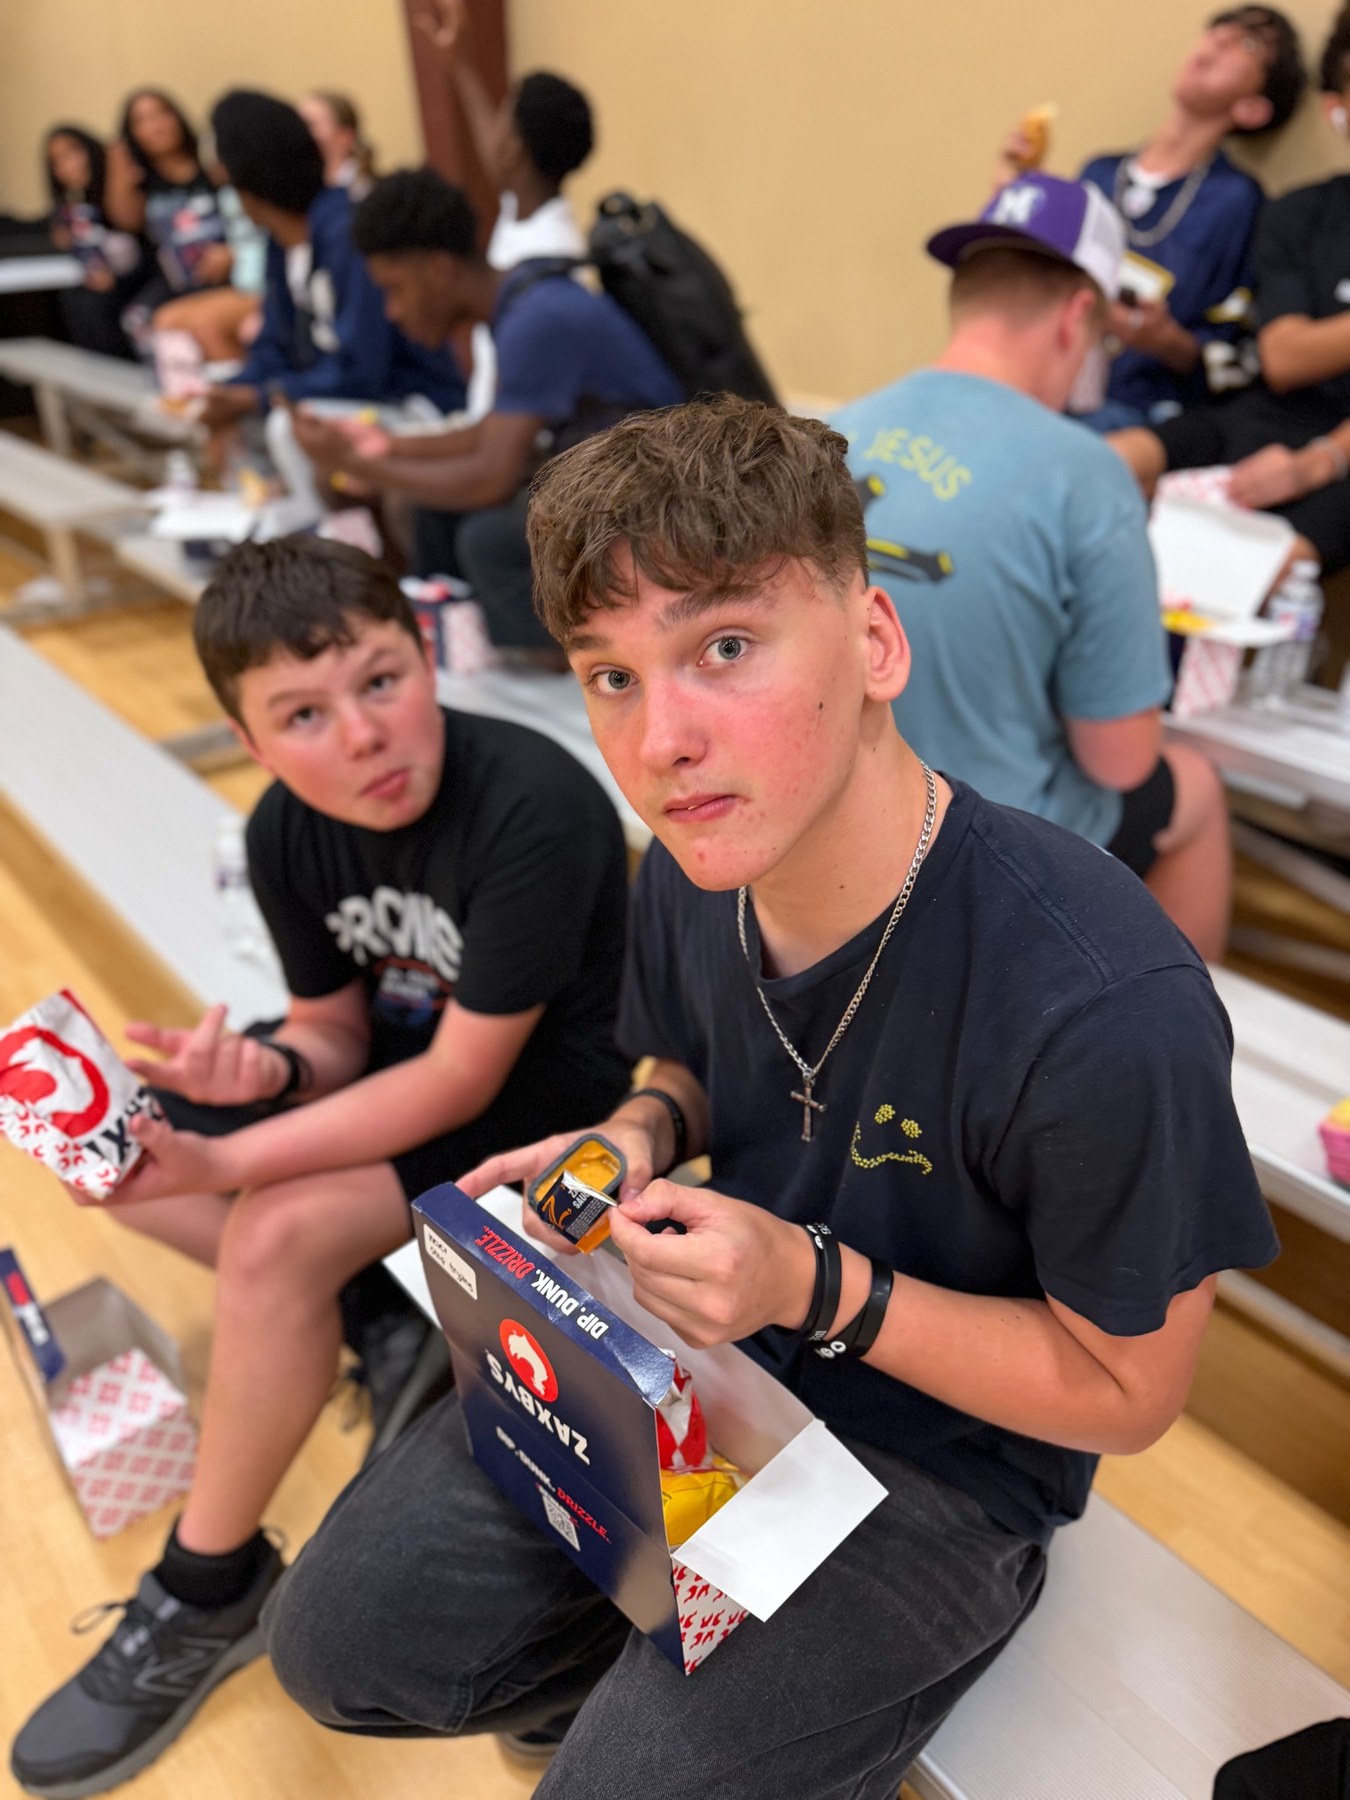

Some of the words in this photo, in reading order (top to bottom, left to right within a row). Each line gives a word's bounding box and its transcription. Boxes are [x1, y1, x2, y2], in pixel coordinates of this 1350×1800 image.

[863, 430, 972, 501] JESUS
[475, 1225, 535, 1280] DRIZZLE.
[531, 1269, 580, 1317] DUNK.
[577, 1306, 609, 1340] DIP.
[486, 1352, 591, 1466] ZAXBYS
